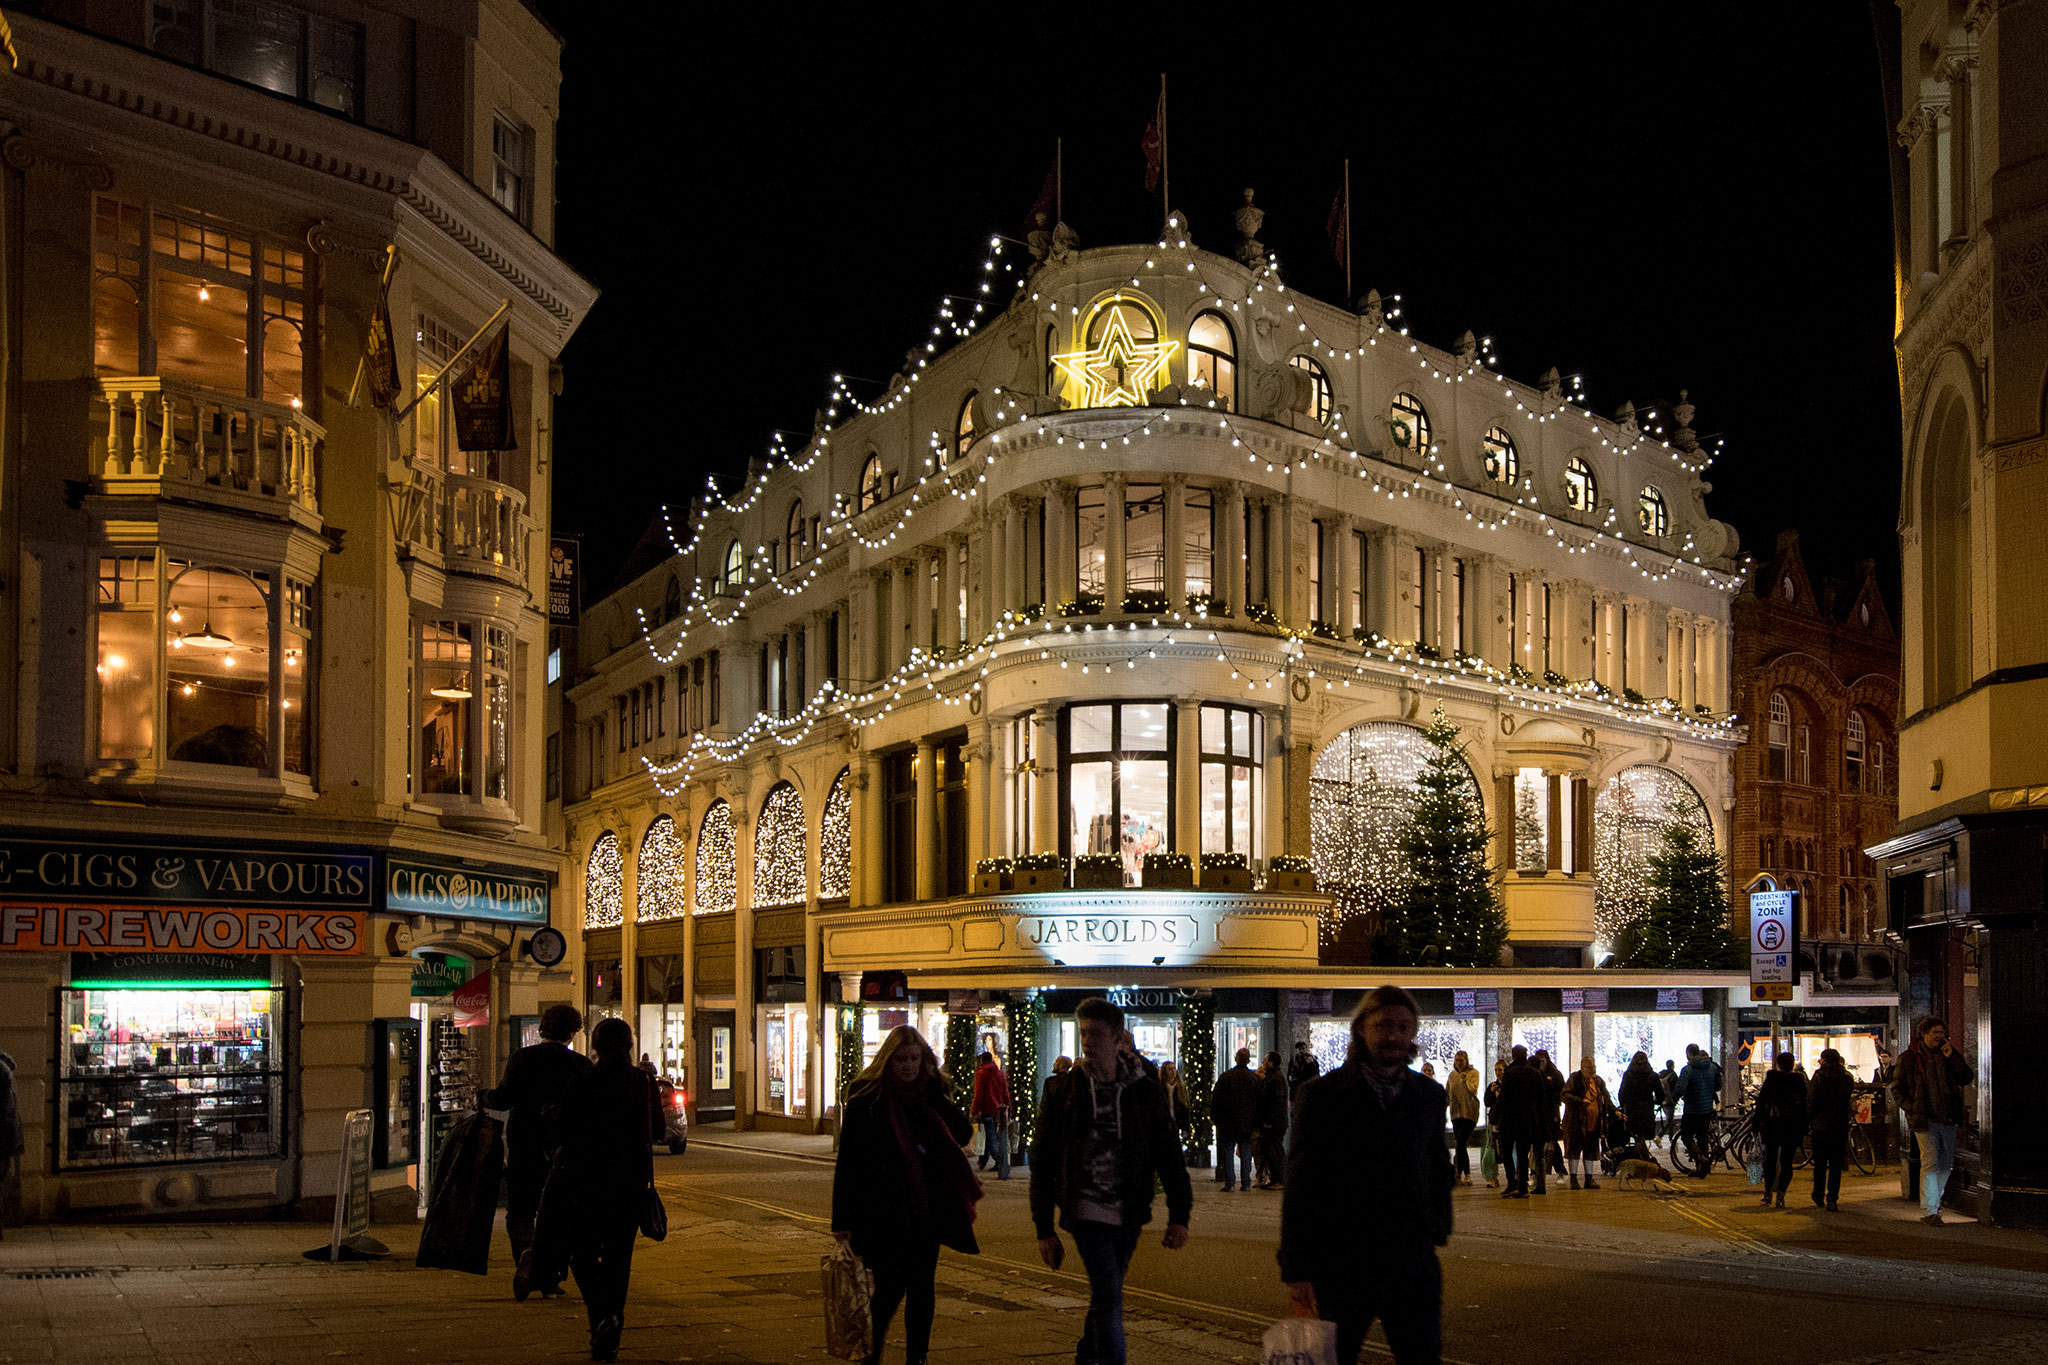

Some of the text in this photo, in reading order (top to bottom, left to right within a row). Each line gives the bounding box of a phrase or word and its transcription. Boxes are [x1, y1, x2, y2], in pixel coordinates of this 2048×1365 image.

[0, 850, 365, 897] E-CIGS & VAPOURS
[1752, 893, 1789, 901] PEDESTRIAN
[1758, 907, 1784, 916] ZONE
[1, 906, 357, 951] FIREWORKS
[1029, 919, 1177, 944] JARROLDS
[113, 953, 239, 969] CONFECTIONERY
[1562, 997, 1583, 1005] DISCO
